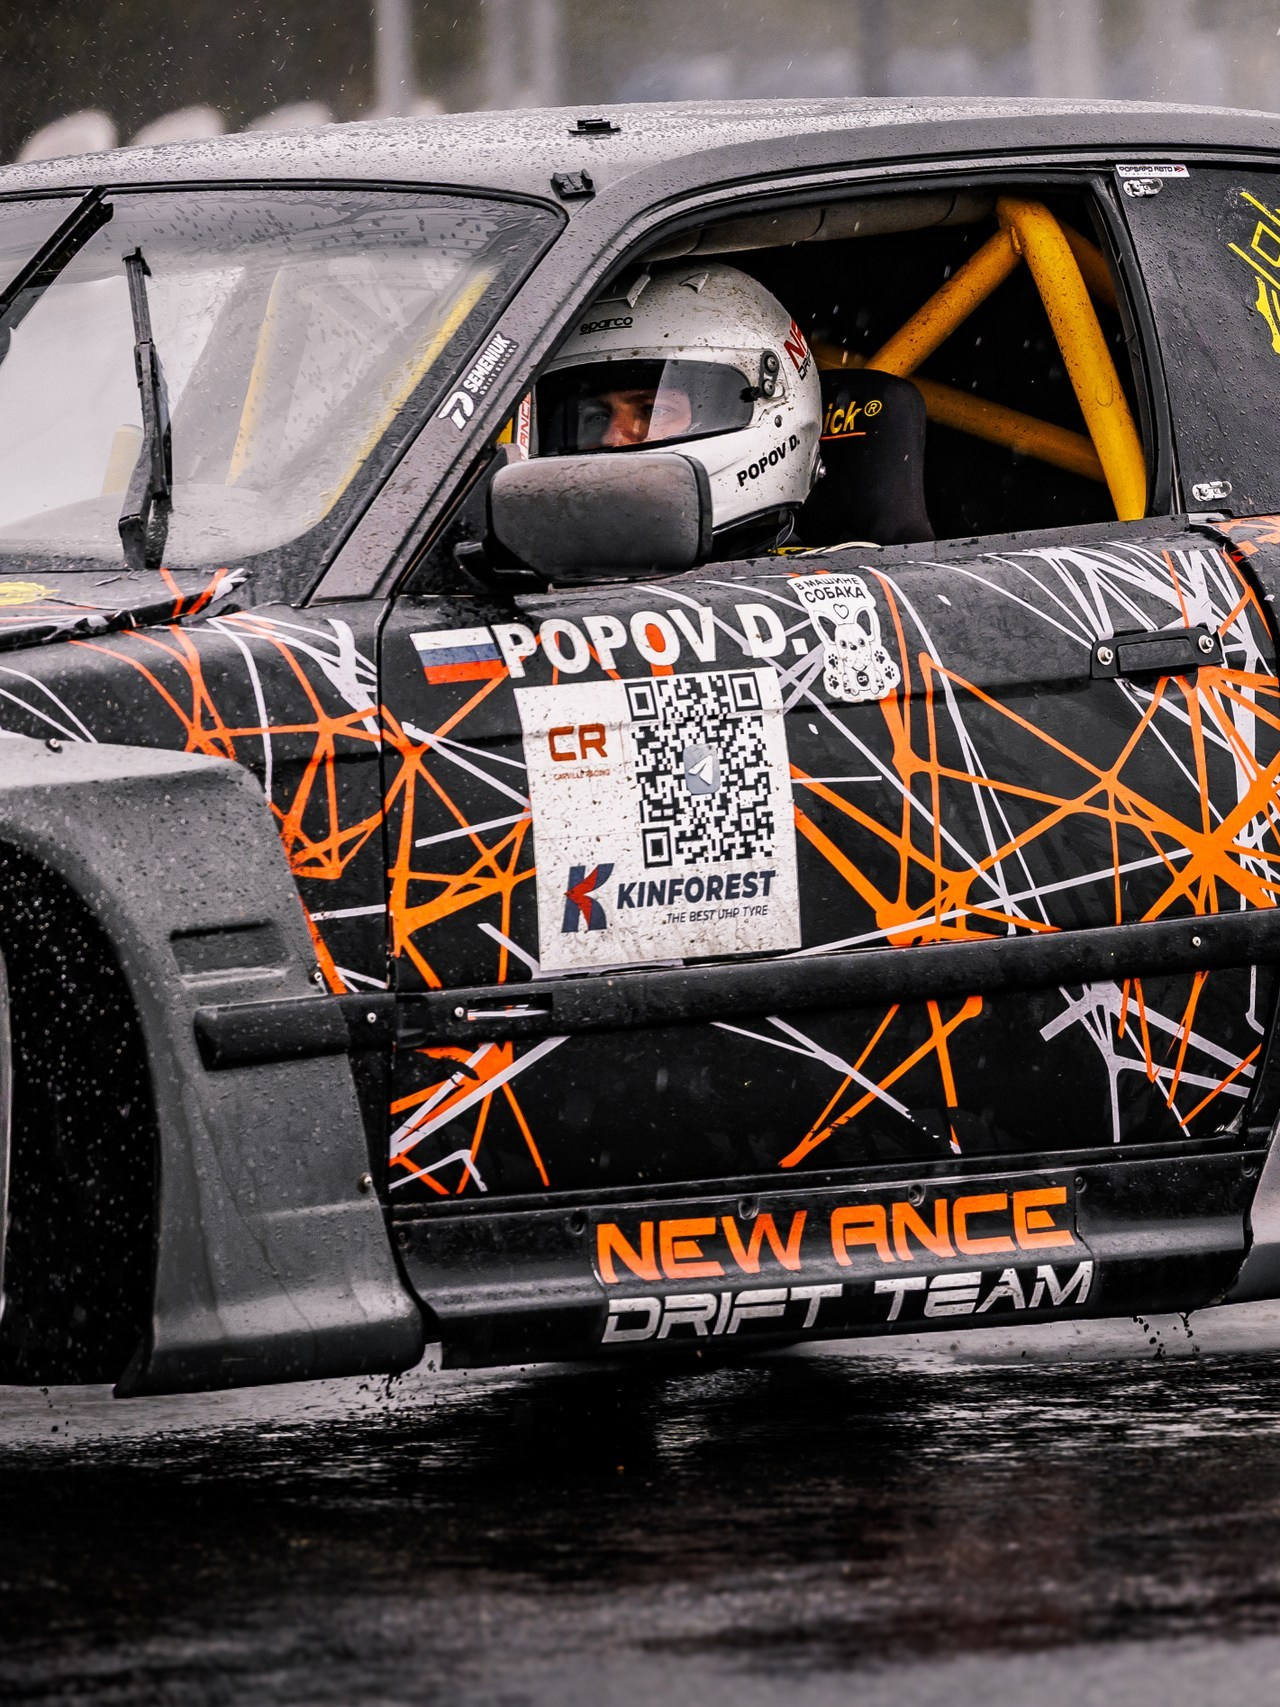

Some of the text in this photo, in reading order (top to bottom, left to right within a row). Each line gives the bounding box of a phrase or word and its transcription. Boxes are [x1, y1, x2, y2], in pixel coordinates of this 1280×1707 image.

[579, 316, 634, 334] sparco
[462, 333, 511, 393] SEMENIUK
[736, 434, 801, 488] POPOV D.
[794, 577, 860, 591] В МАШИНЕ
[804, 585, 867, 603] СОБАКА
[491, 602, 810, 679] POPOV D.
[548, 723, 608, 762] CR
[616, 870, 776, 909] KINFOREST
[667, 911, 686, 924] THE
[689, 908, 714, 922] BEST
[743, 904, 768, 917] TYRE
[596, 1186, 1076, 1284] NEW ANCE
[601, 1260, 1094, 1344] DRIFT TEAM
